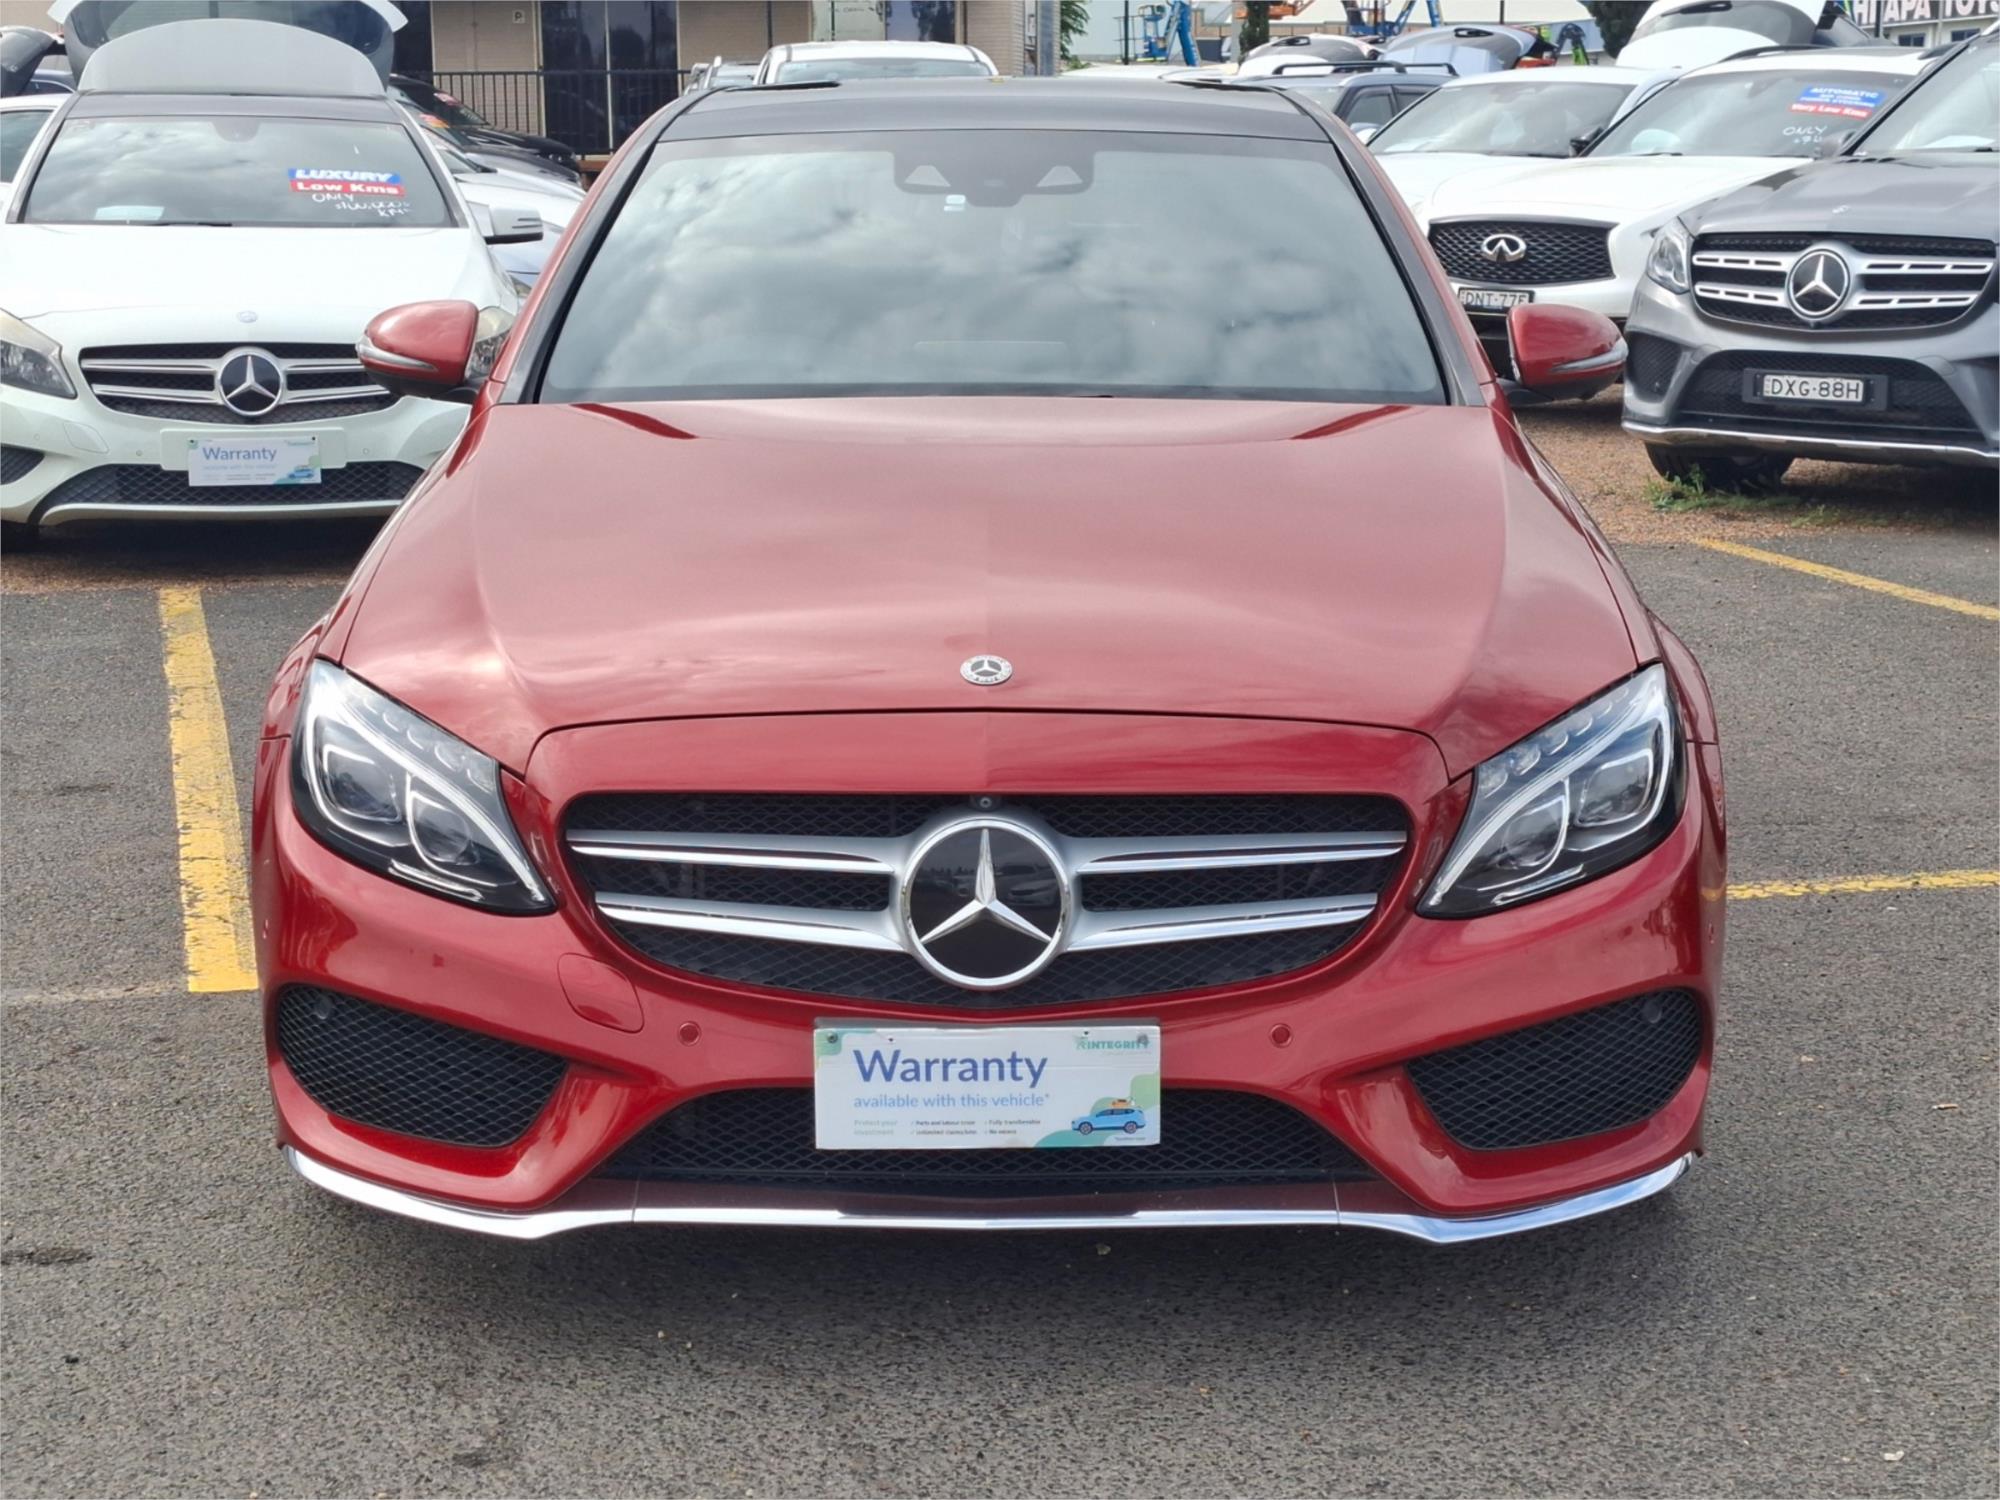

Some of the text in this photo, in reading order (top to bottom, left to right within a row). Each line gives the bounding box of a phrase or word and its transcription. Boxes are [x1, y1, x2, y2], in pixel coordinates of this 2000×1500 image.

[1809, 88, 1879, 99] AUTOMATIC
[1818, 105, 1840, 113] Low
[1783, 125, 1828, 136] ONLY
[295, 168, 393, 182] LUXURY
[297, 182, 399, 194] Low Kms
[311, 193, 354, 203] ONLY
[202, 446, 277, 461] Warranty
[853, 1049, 1048, 1089] Warranty
[854, 1094, 919, 1108] available
[923, 1094, 957, 1108] with
[961, 1093, 988, 1107] this
